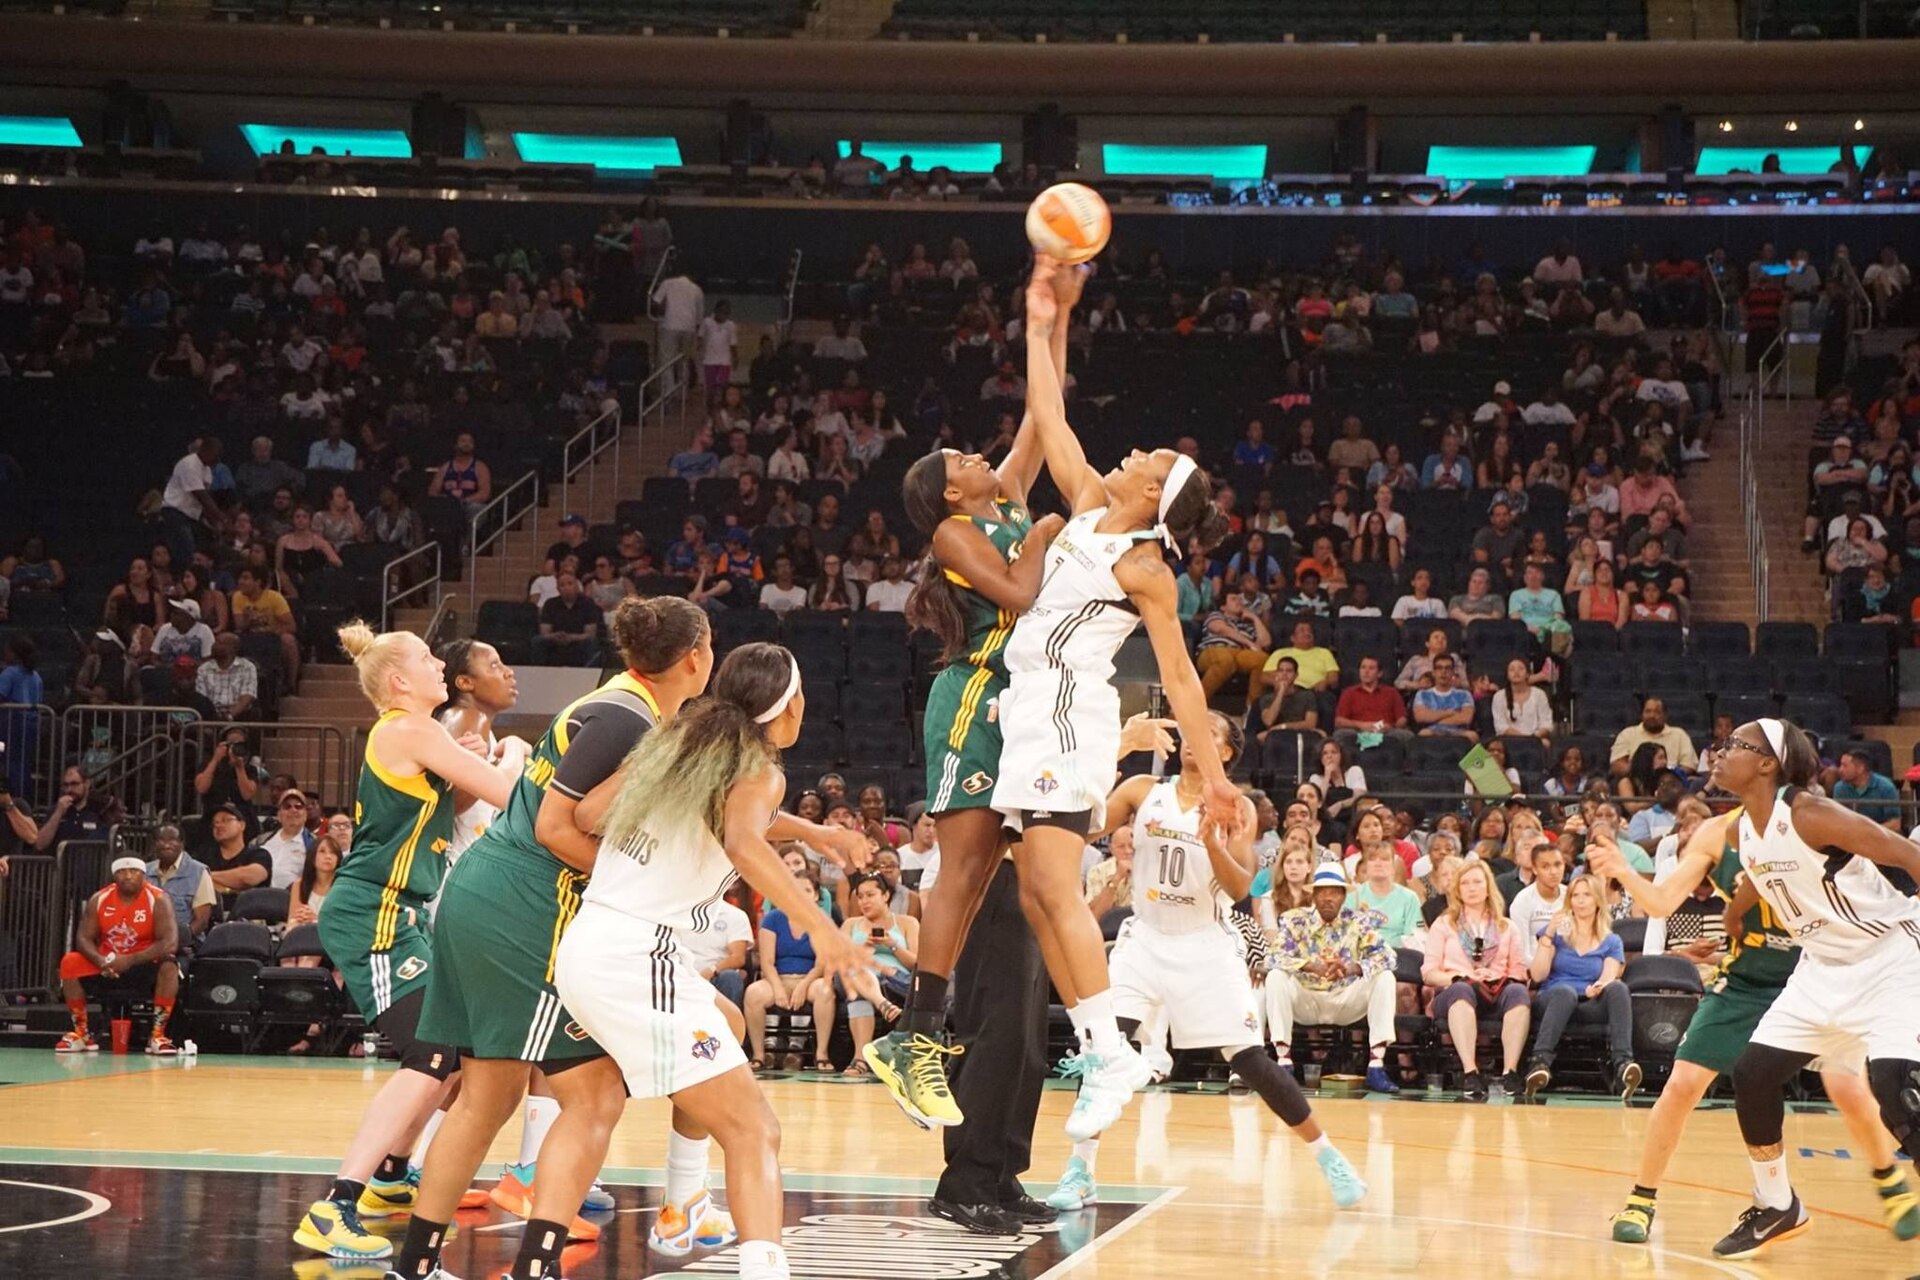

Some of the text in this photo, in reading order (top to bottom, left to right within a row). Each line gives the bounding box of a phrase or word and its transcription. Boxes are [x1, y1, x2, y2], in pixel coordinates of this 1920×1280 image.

[1159, 845, 1186, 888] 10
[1160, 891, 1196, 905] boost
[1765, 878, 1802, 922] 17
[133, 909, 147, 923] 25
